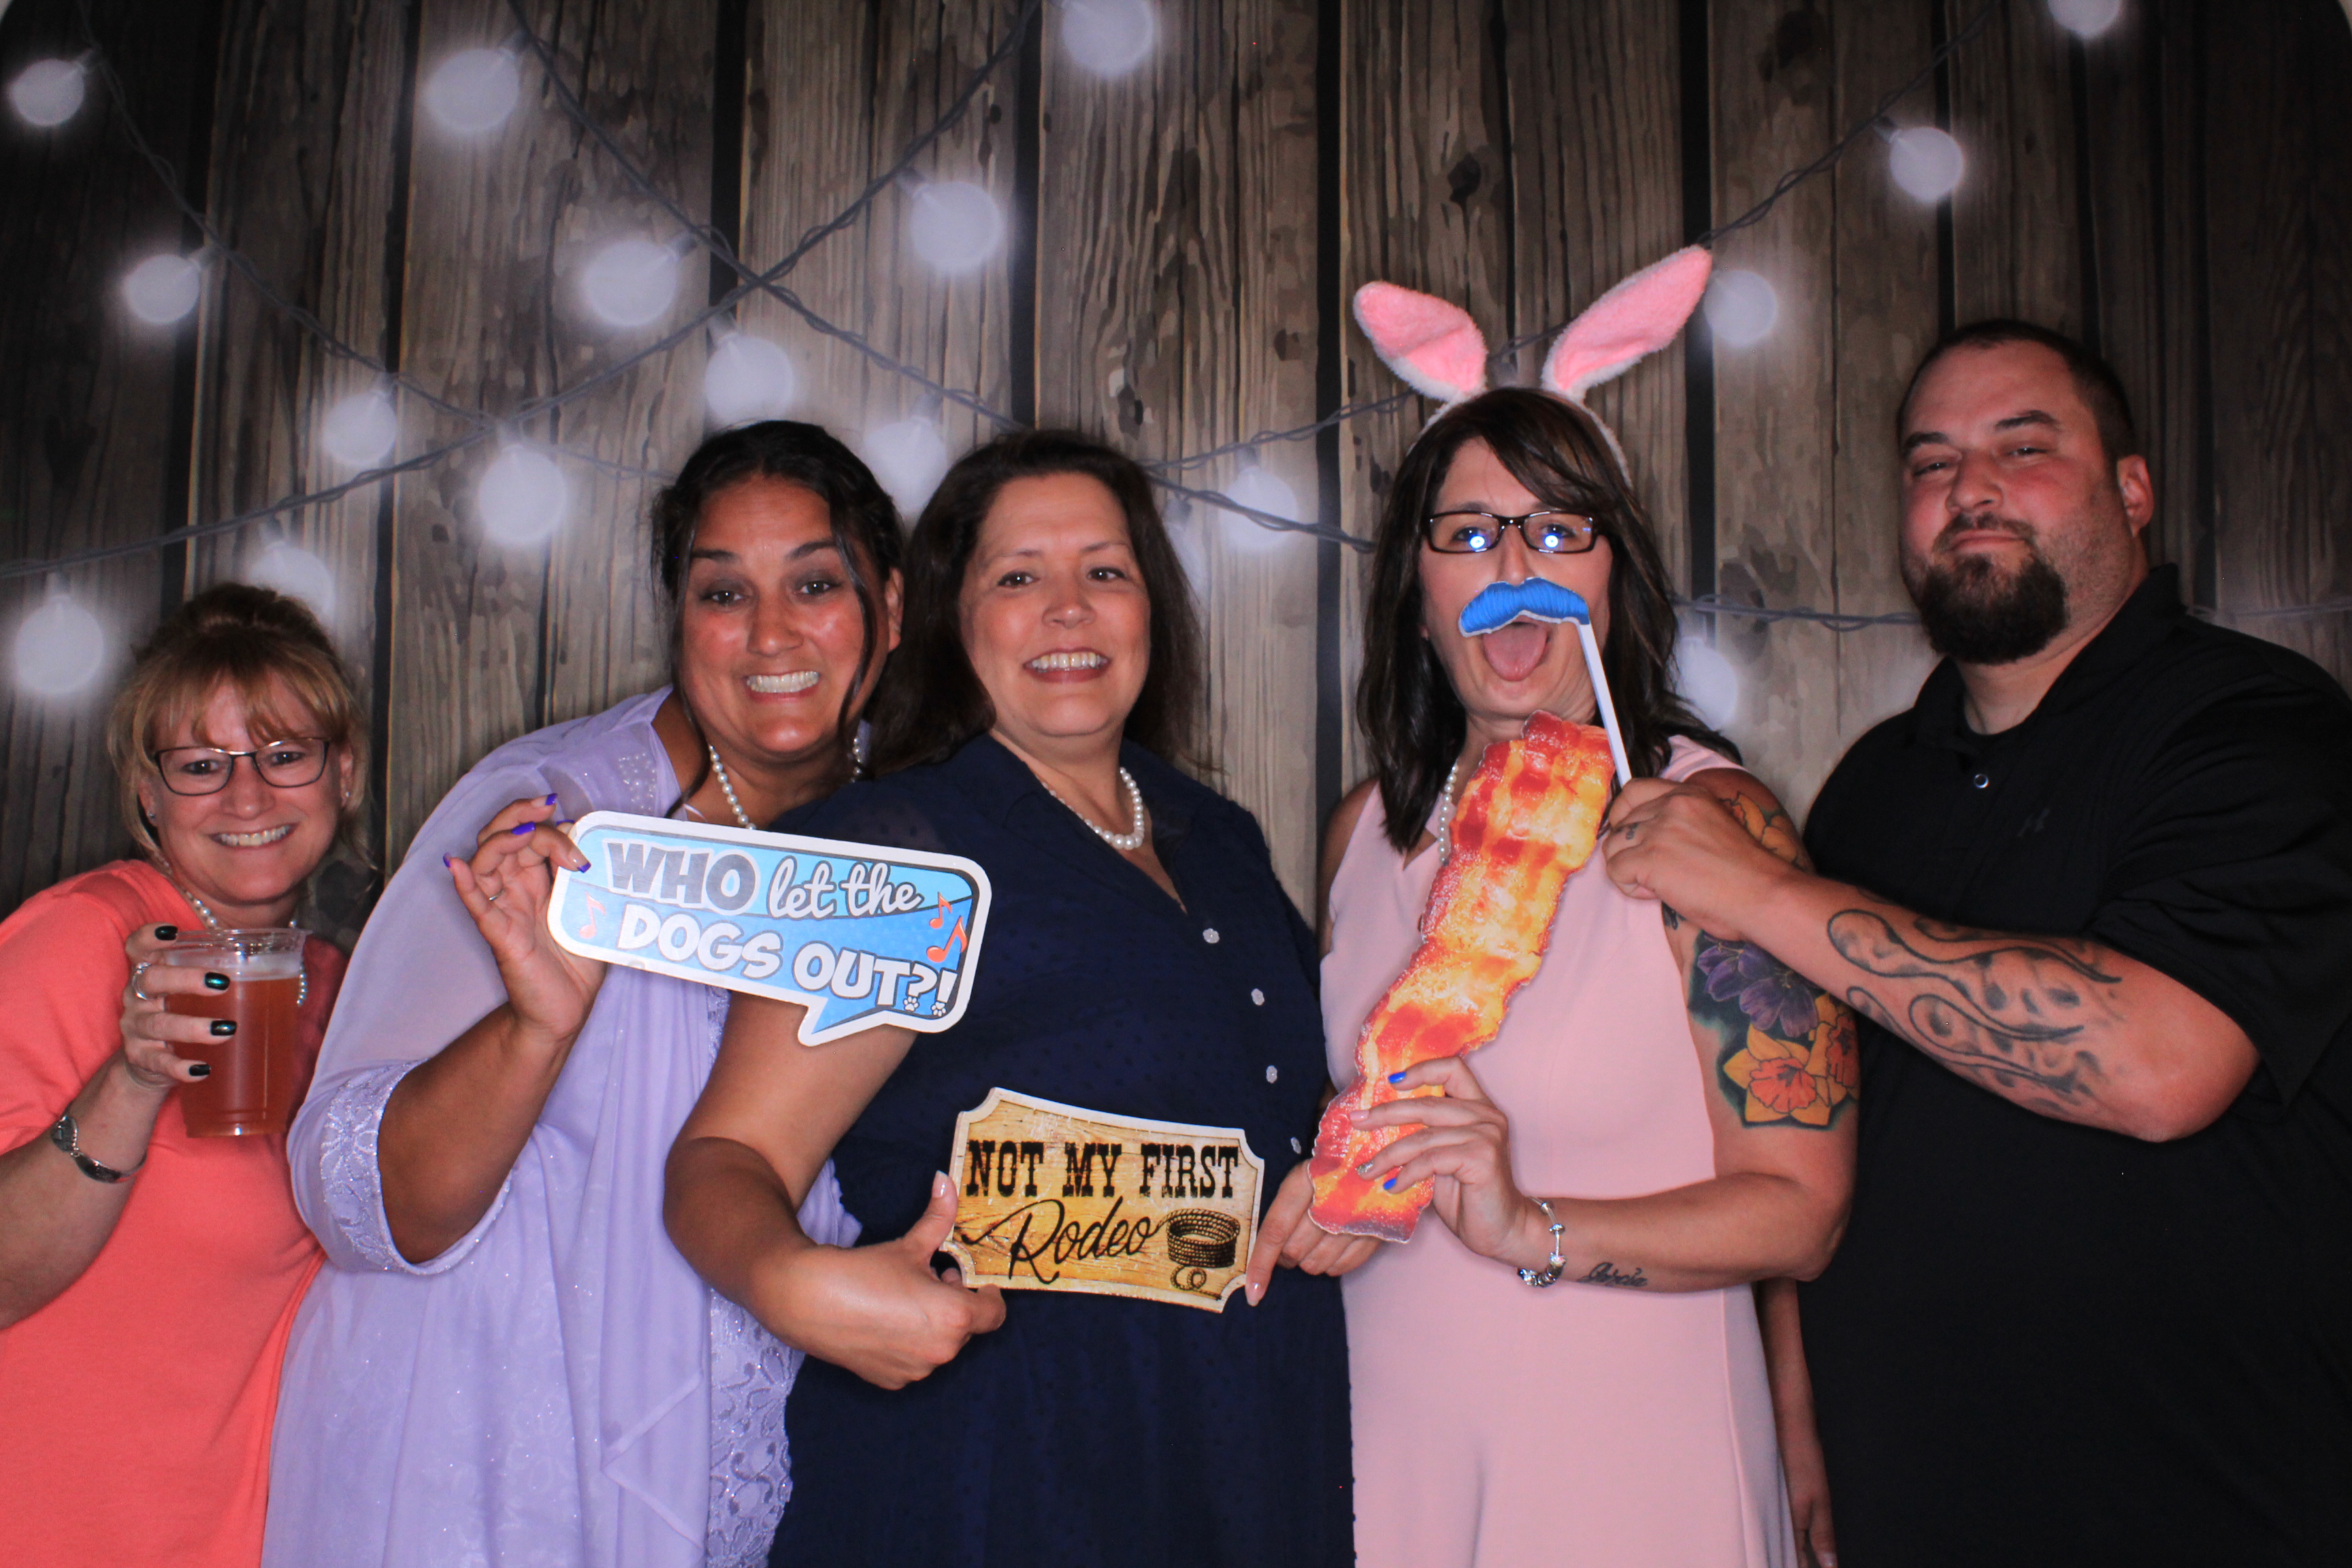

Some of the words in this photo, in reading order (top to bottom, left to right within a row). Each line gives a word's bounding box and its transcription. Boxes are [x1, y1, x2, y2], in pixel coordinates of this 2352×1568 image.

[605, 840, 759, 914] WHO
[768, 855, 837, 919] let
[840, 862, 924, 916] the
[617, 903, 783, 979] DOGS
[794, 939, 958, 1016] OUT?!
[966, 1140, 1043, 1197] NOT
[1062, 1142, 1122, 1198] MY
[1140, 1143, 1239, 1198] FIRST
[962, 1196, 1158, 1284] Rodeo
